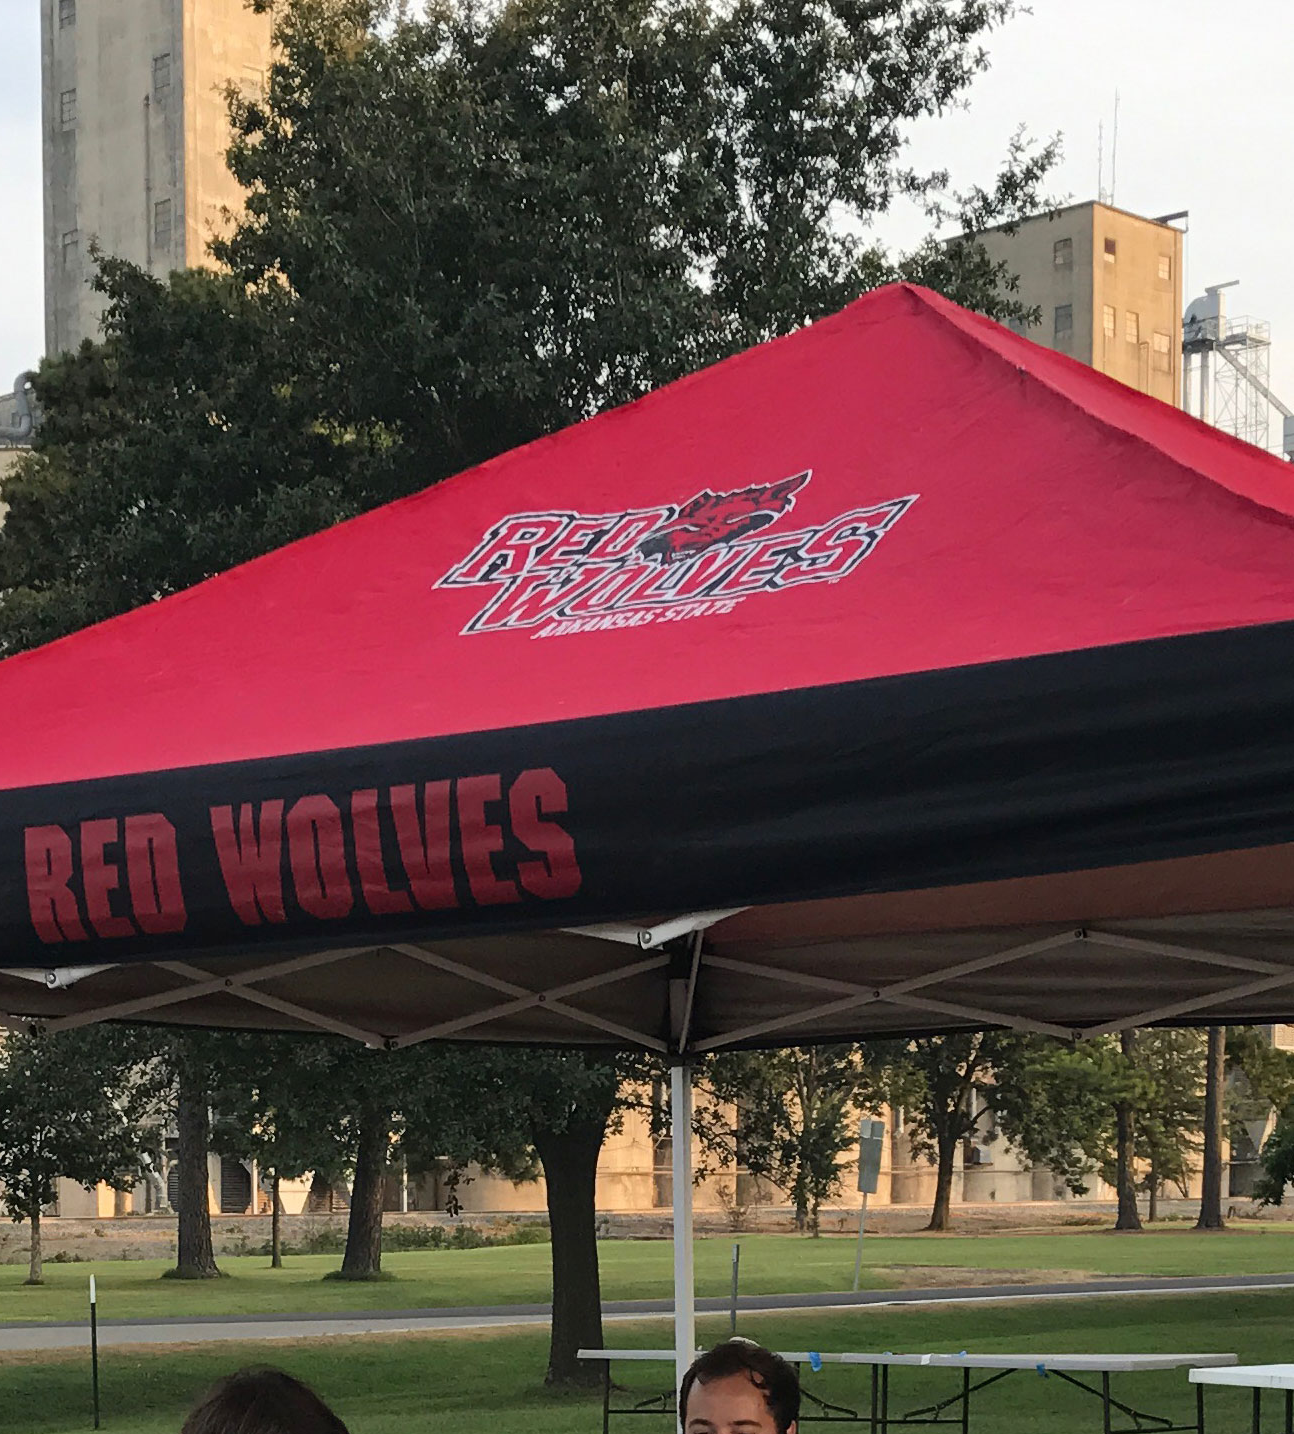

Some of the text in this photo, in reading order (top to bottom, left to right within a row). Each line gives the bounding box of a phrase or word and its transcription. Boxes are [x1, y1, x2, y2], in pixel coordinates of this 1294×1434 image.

[431, 503, 682, 590] RED
[459, 494, 920, 635] WOLVES
[529, 596, 747, 640] ARKANSAS STATE
[24, 767, 582, 944] RED WOLVES
